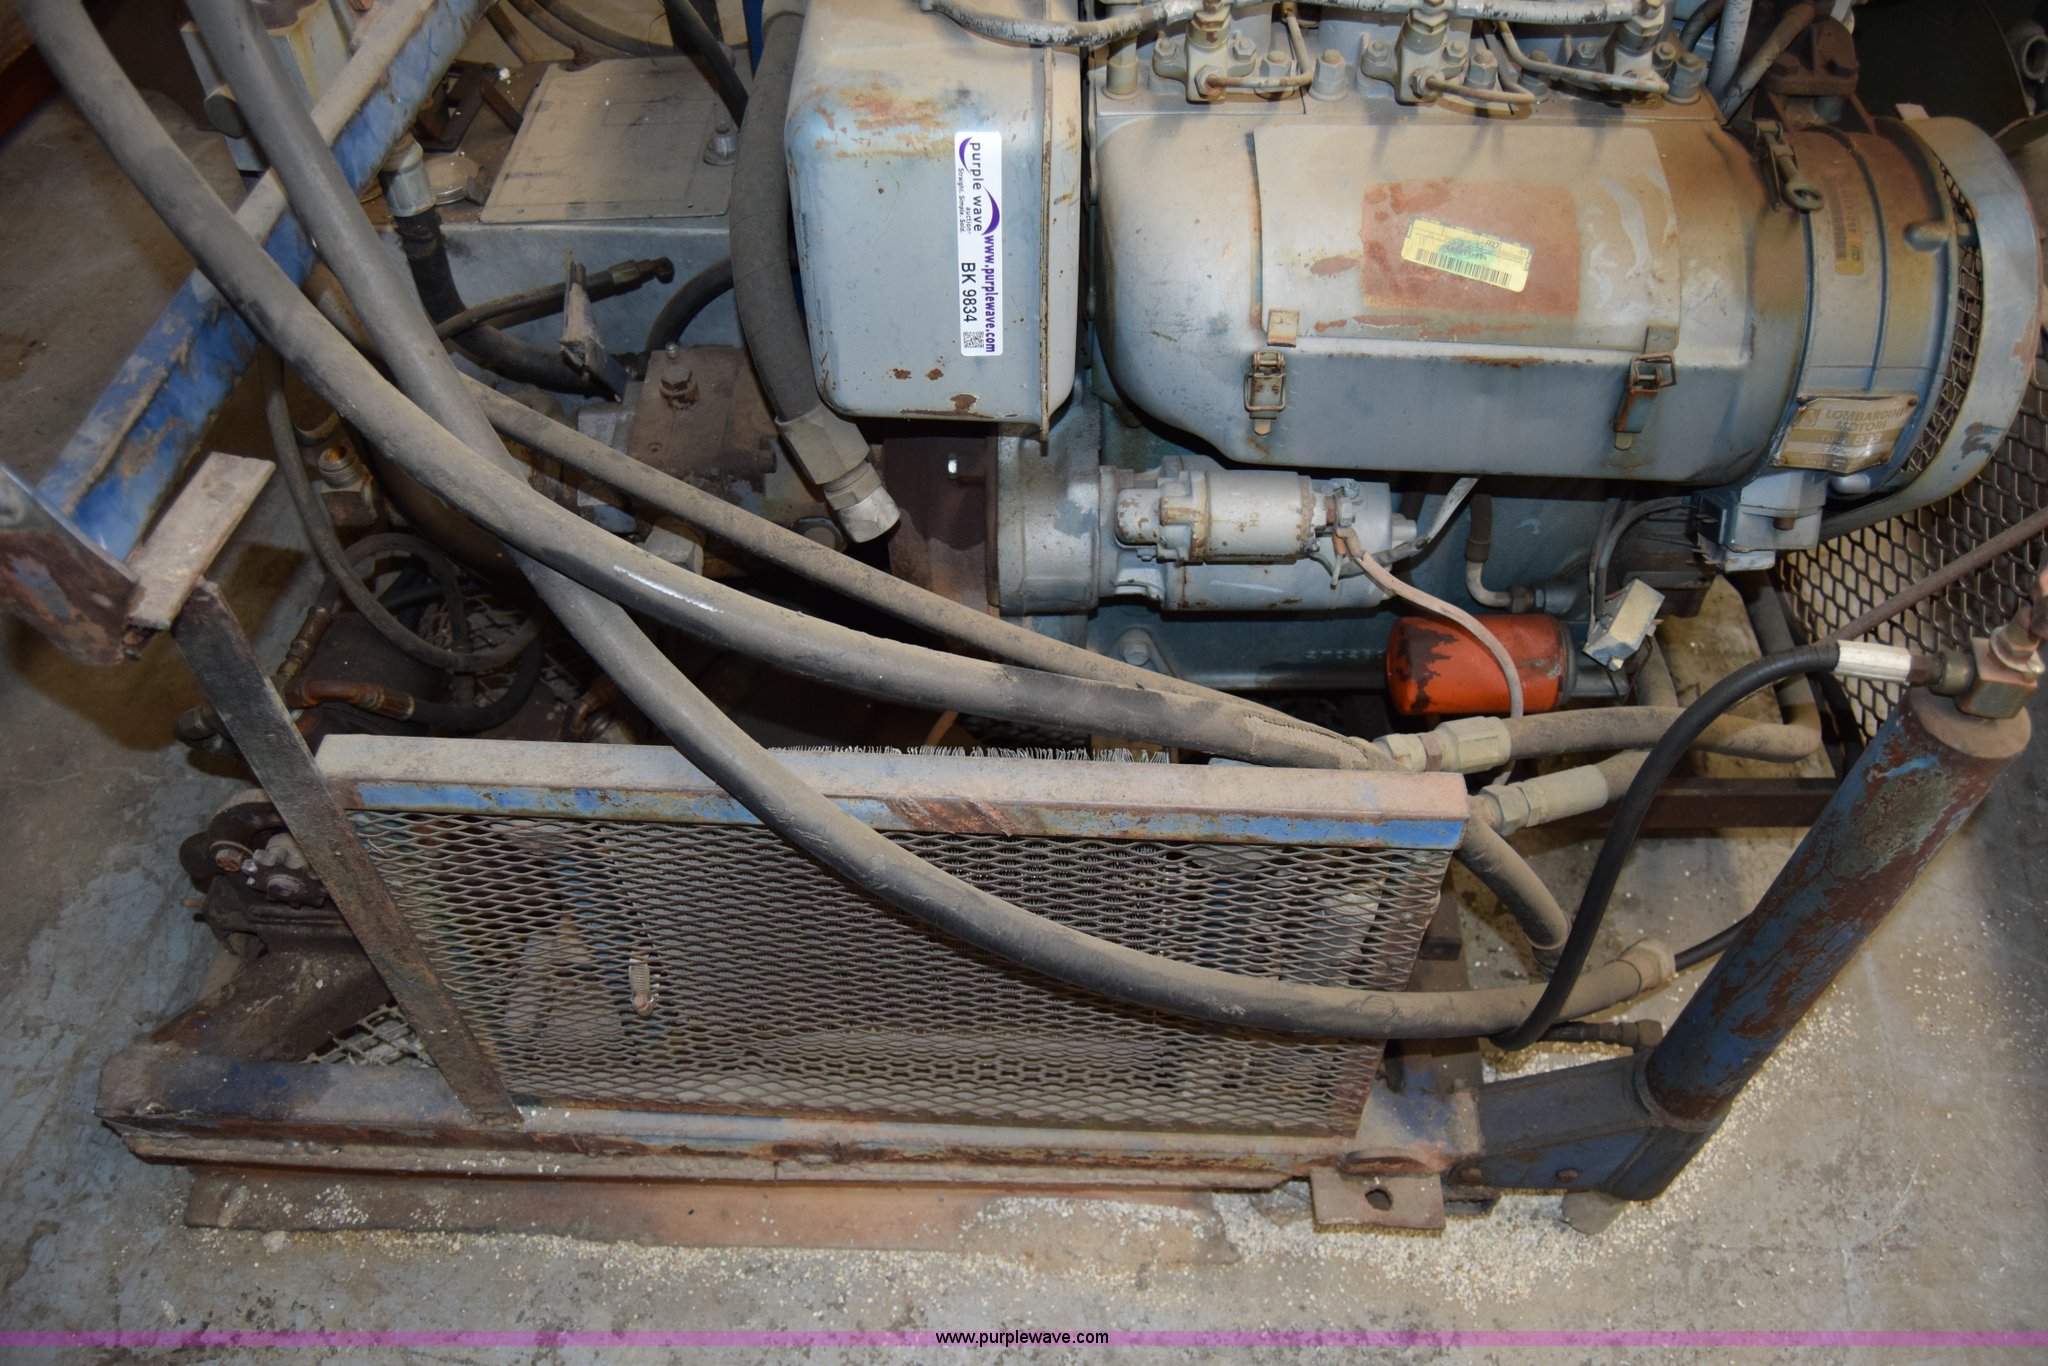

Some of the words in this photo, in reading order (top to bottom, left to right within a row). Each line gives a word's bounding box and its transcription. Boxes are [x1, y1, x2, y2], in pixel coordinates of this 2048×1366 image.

[957, 167, 965, 194] Straight.
[969, 142, 984, 190] purple
[958, 195, 966, 217] Simple.
[973, 195, 983, 232] wave
[961, 262, 976, 284] BK
[962, 289, 978, 323] 9834
[980, 235, 999, 353] www.purplewave.com
[1825, 407, 1904, 421] LOMBARDINI
